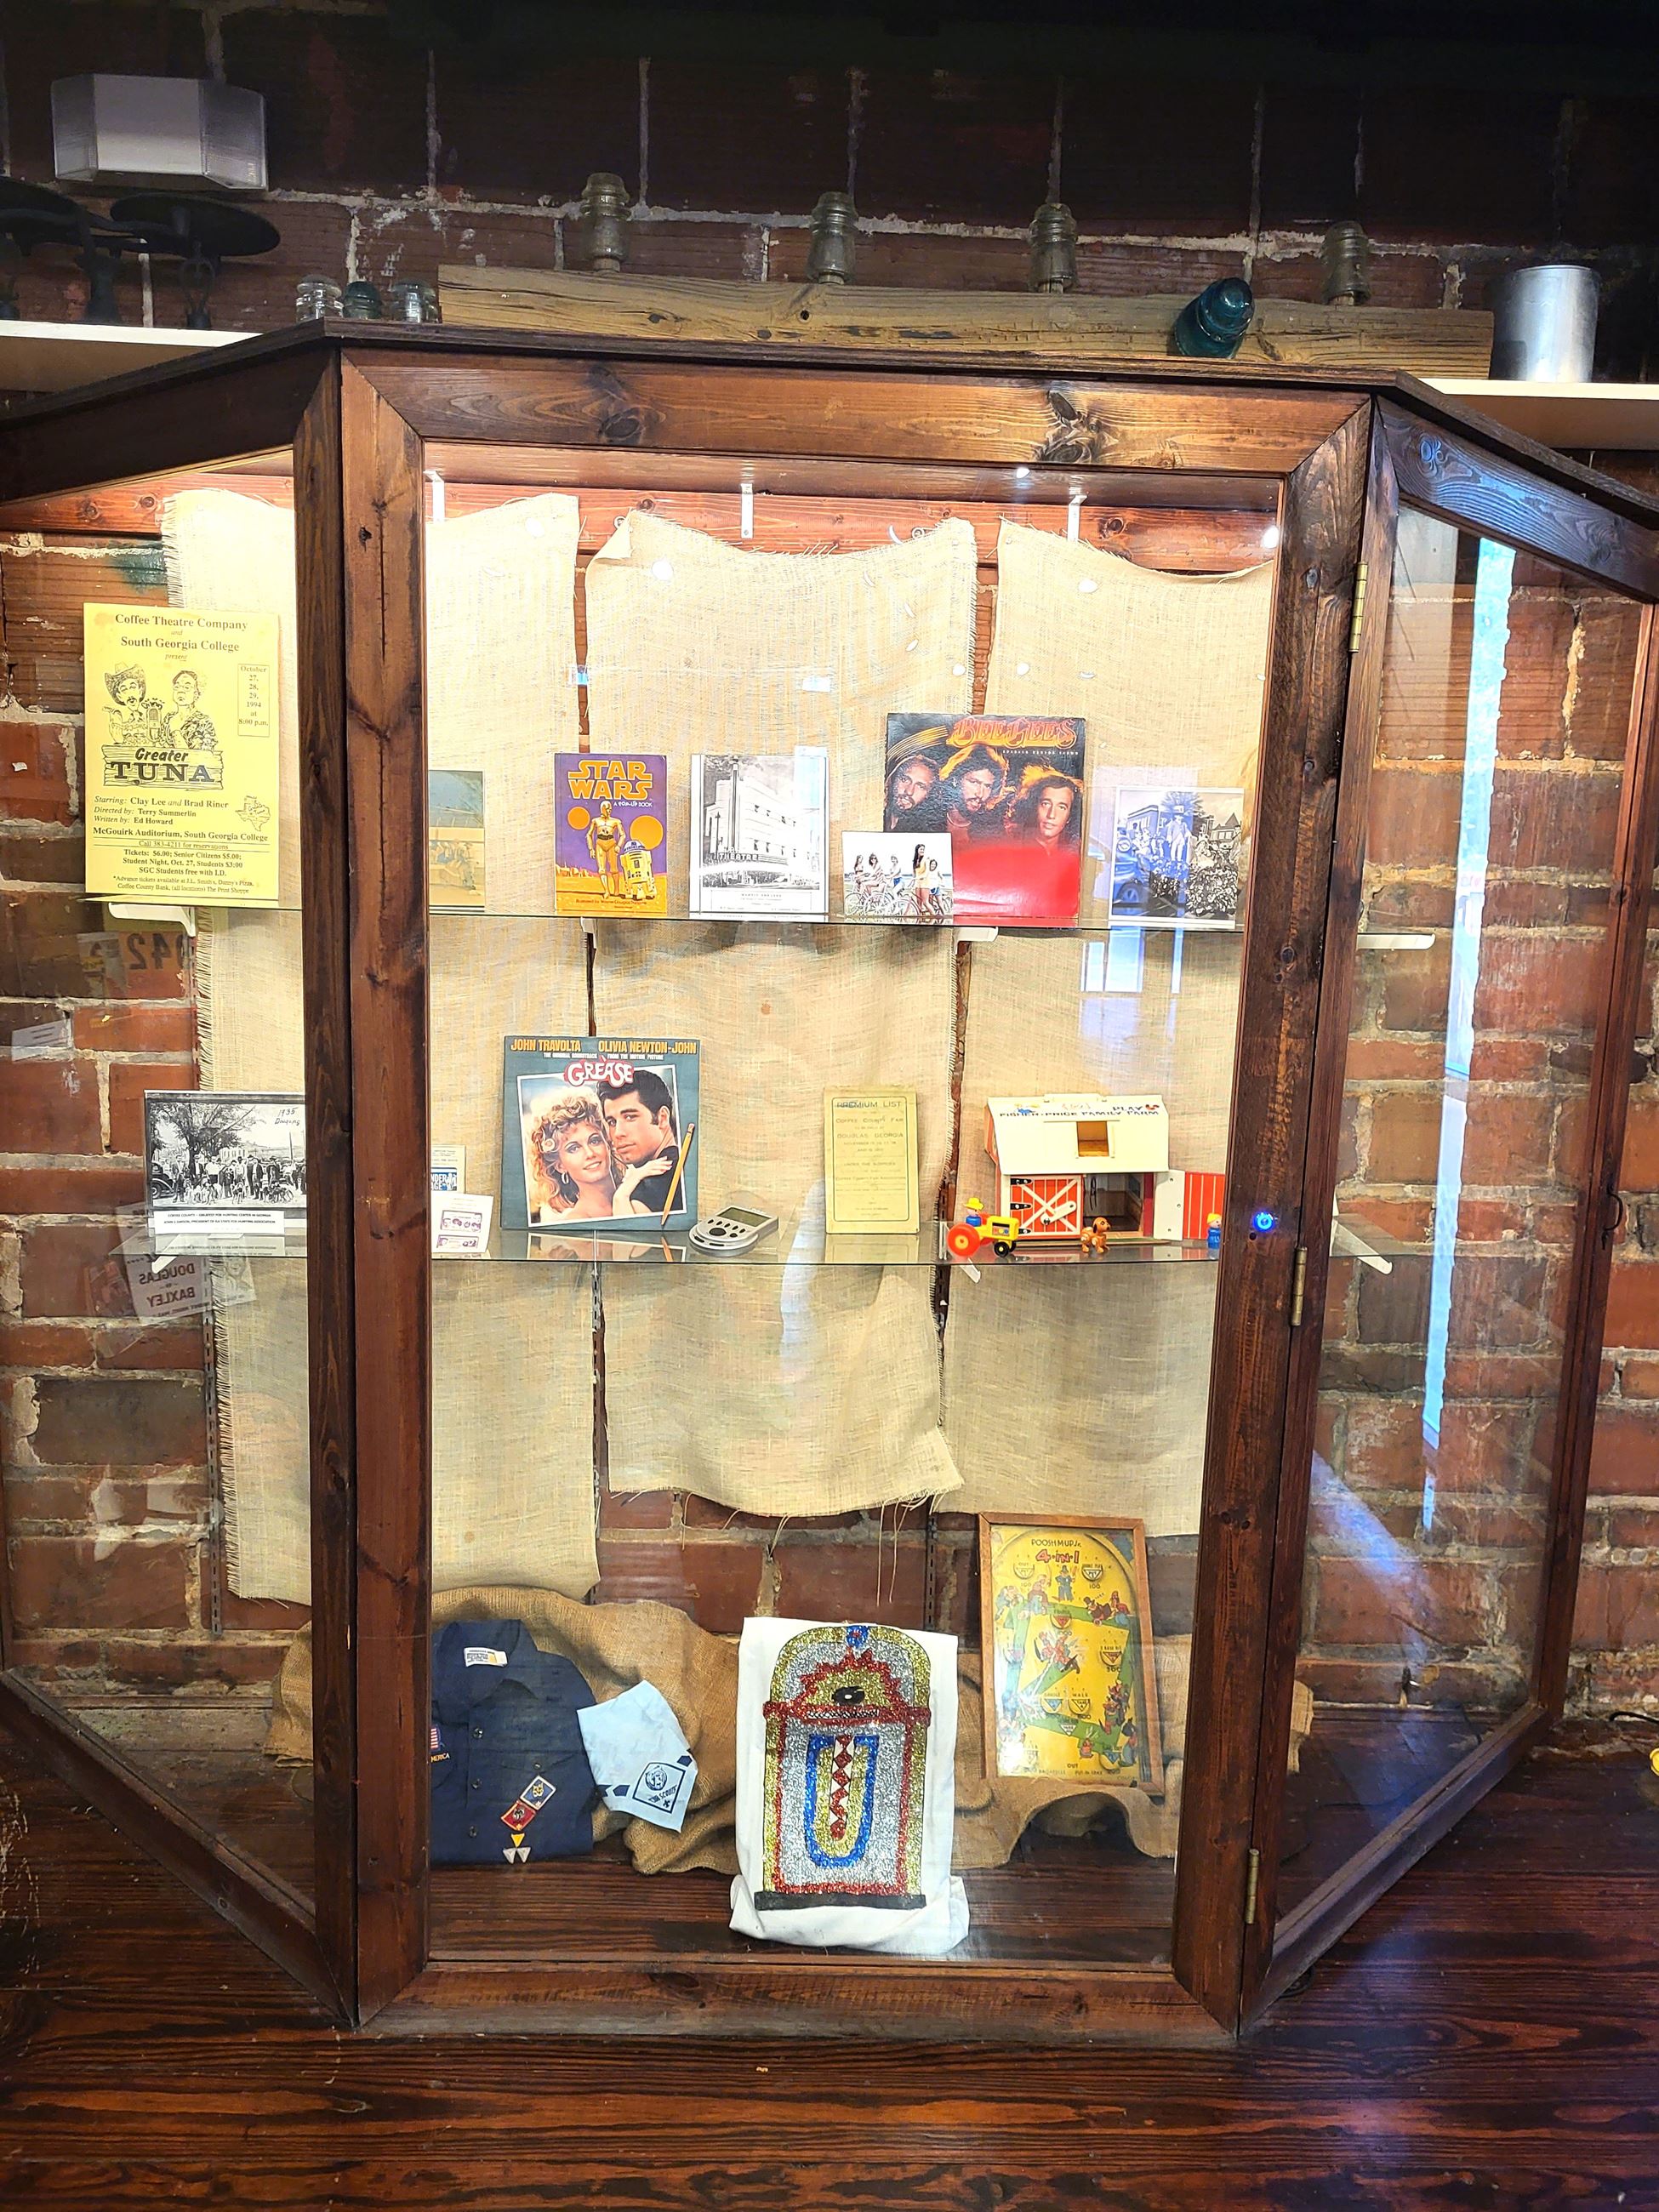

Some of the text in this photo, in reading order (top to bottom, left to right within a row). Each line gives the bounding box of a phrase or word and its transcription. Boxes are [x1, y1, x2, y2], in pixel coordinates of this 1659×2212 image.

[115, 613, 248, 631] Coffee Theatre Company
[121, 636, 239, 652] South Georgia College
[134, 748, 188, 762] Greater
[111, 761, 215, 783] TUNA
[568, 759, 653, 780] STAR
[568, 779, 653, 800] WARS
[94, 796, 127, 805] Starring:
[130, 797, 148, 807] Clay
[138, 808, 157, 817] Terry
[93, 827, 133, 836] McGouirk
[135, 829, 183, 838] Auditorium,
[208, 832, 238, 841] Georgia
[240, 834, 268, 842] College
[510, 1039, 697, 1054] JOHN TRAVOLTA OLIVIA NEWTON-JOHN
[567, 1061, 633, 1086] GREASE
[430, 1173, 448, 1183] NDER
[430, 1753, 450, 1762] MERICA
